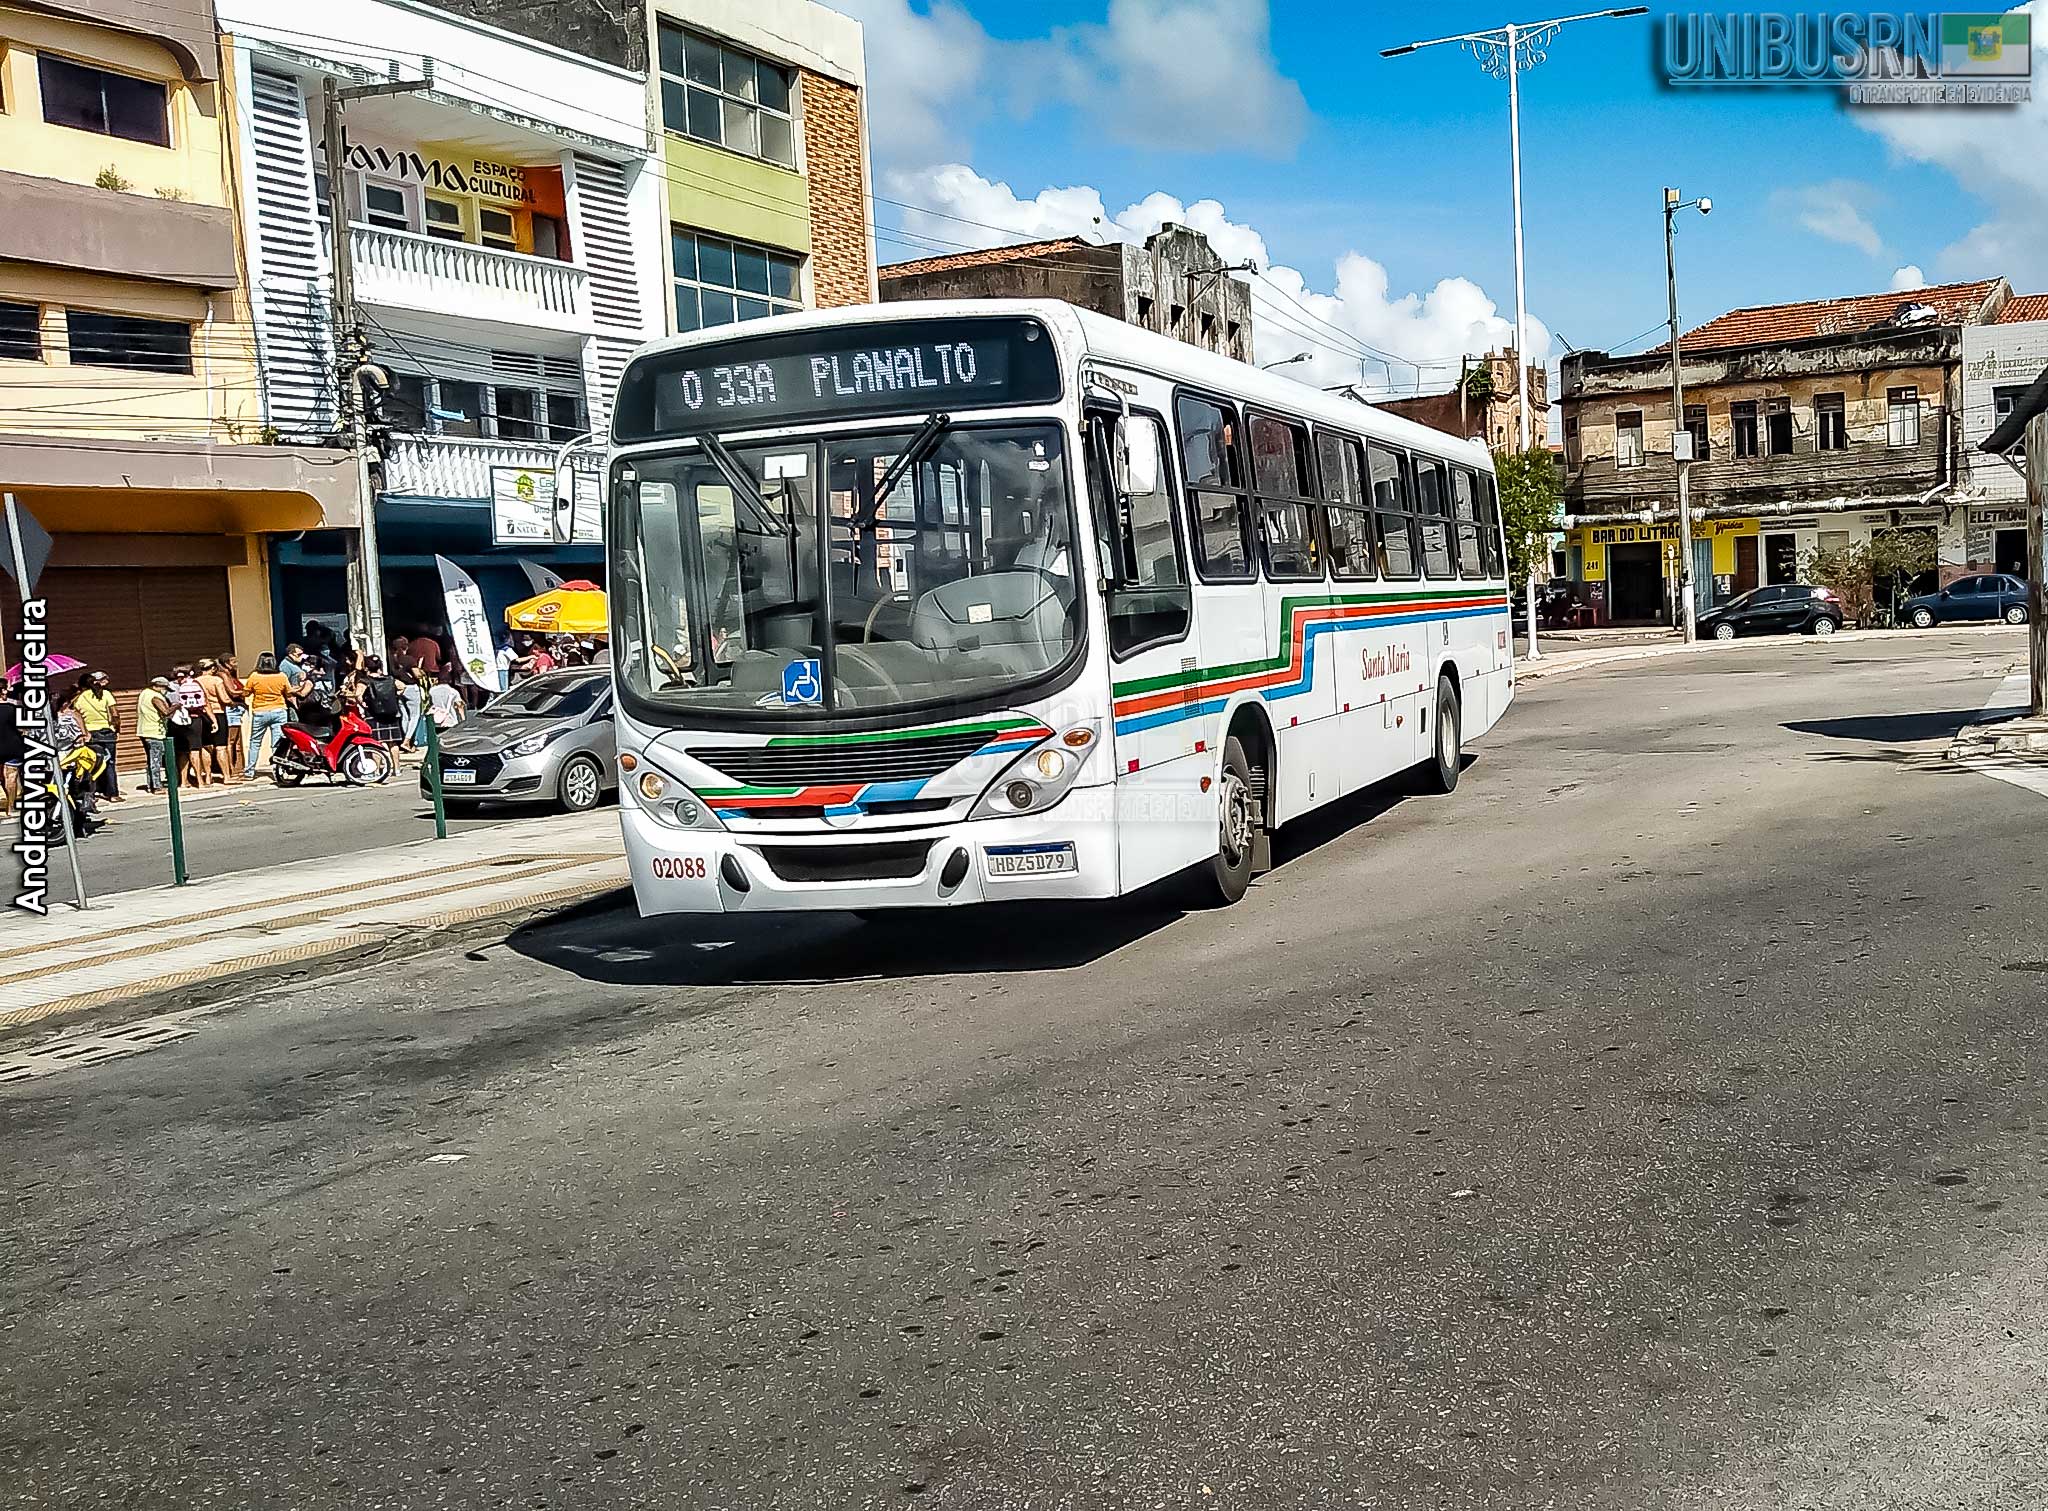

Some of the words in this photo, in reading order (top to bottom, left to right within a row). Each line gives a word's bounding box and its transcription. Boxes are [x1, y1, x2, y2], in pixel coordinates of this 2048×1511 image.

[473, 159, 527, 183] ESPAÇO
[469, 176, 537, 204] CULTURAL
[713, 363, 778, 407] 33A
[810, 342, 977, 398] PLANALTO
[1592, 528, 1616, 544] BAR
[1619, 527, 1635, 542] DO
[1586, 561, 1599, 571] 241
[1362, 647, 1386, 681] Santa
[1386, 643, 1411, 676] Maria
[652, 857, 706, 879] 02088
[996, 854, 1065, 873] HBZ5D79
